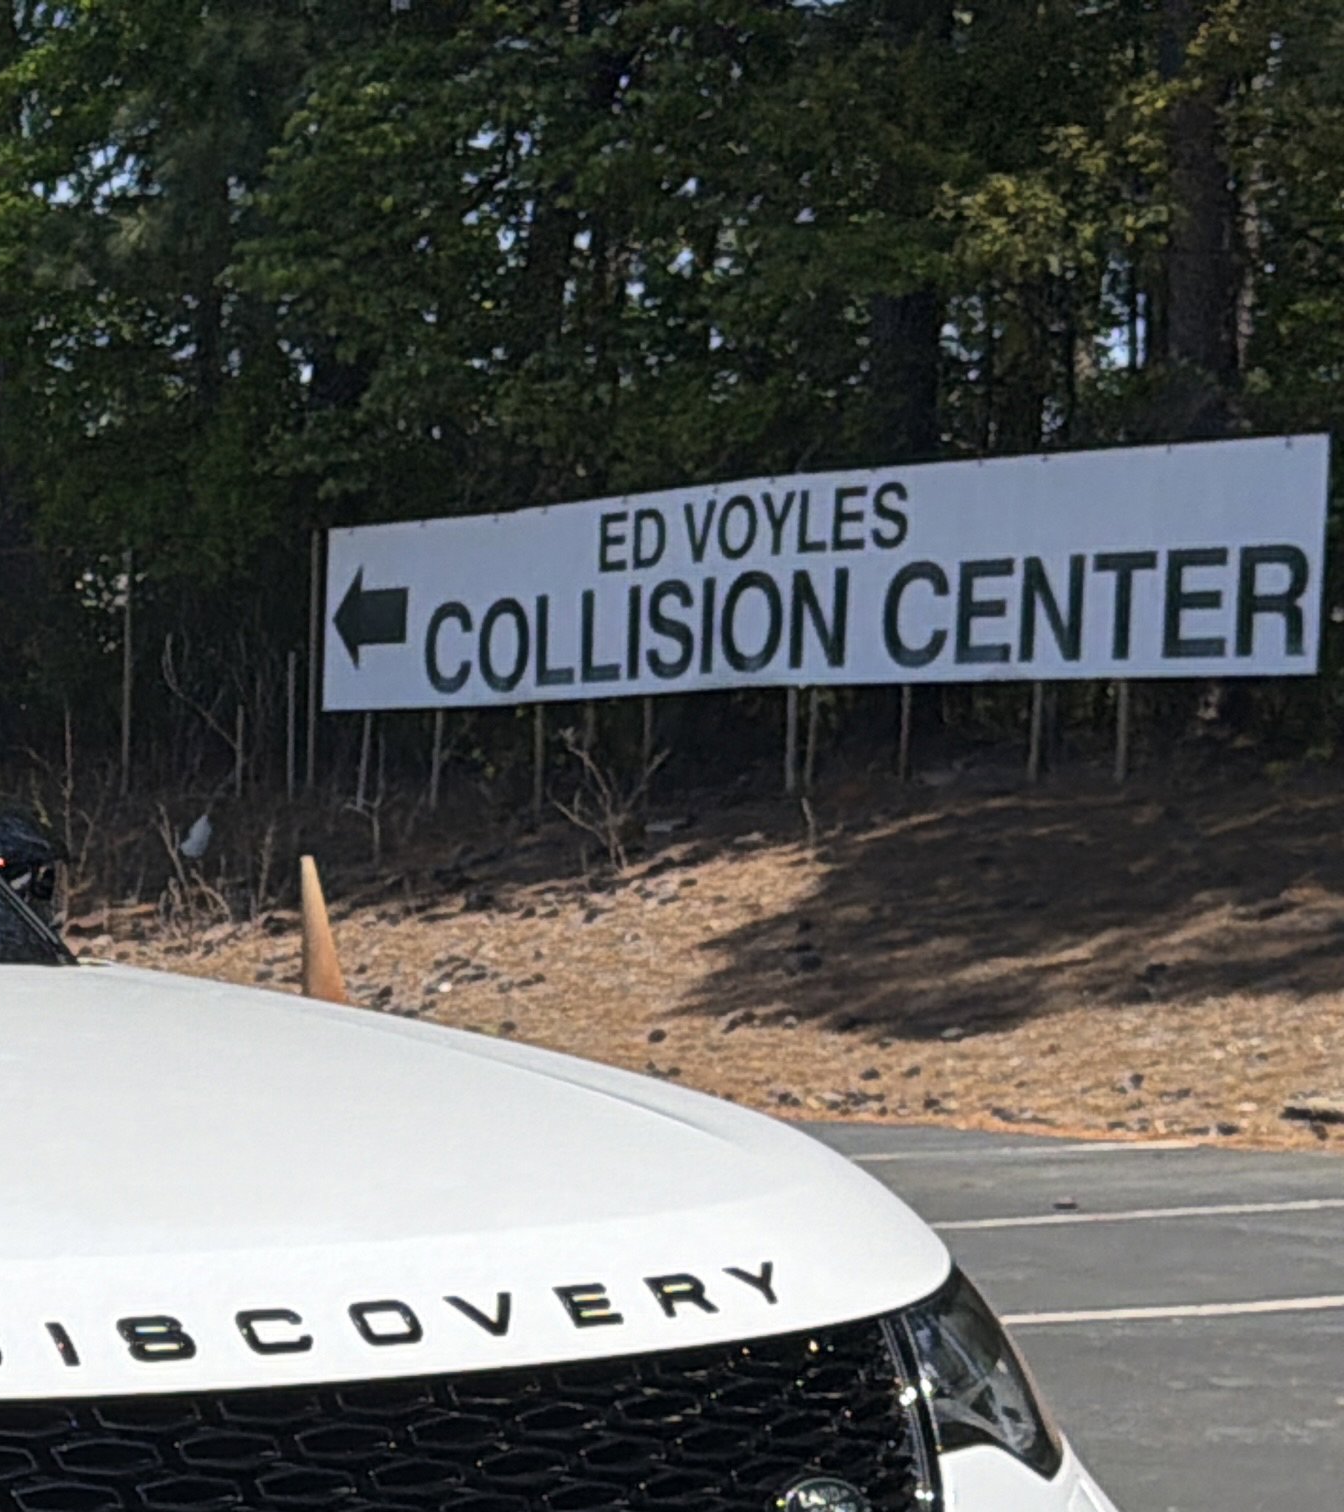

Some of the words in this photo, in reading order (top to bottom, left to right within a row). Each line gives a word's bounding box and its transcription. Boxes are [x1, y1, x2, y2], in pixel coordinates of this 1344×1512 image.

[597, 507, 667, 574] ED
[683, 480, 910, 564] VOYLES
[423, 565, 850, 696] COLLISION
[881, 543, 1311, 670] CENTER
[798, 1485, 841, 1508] LAND
